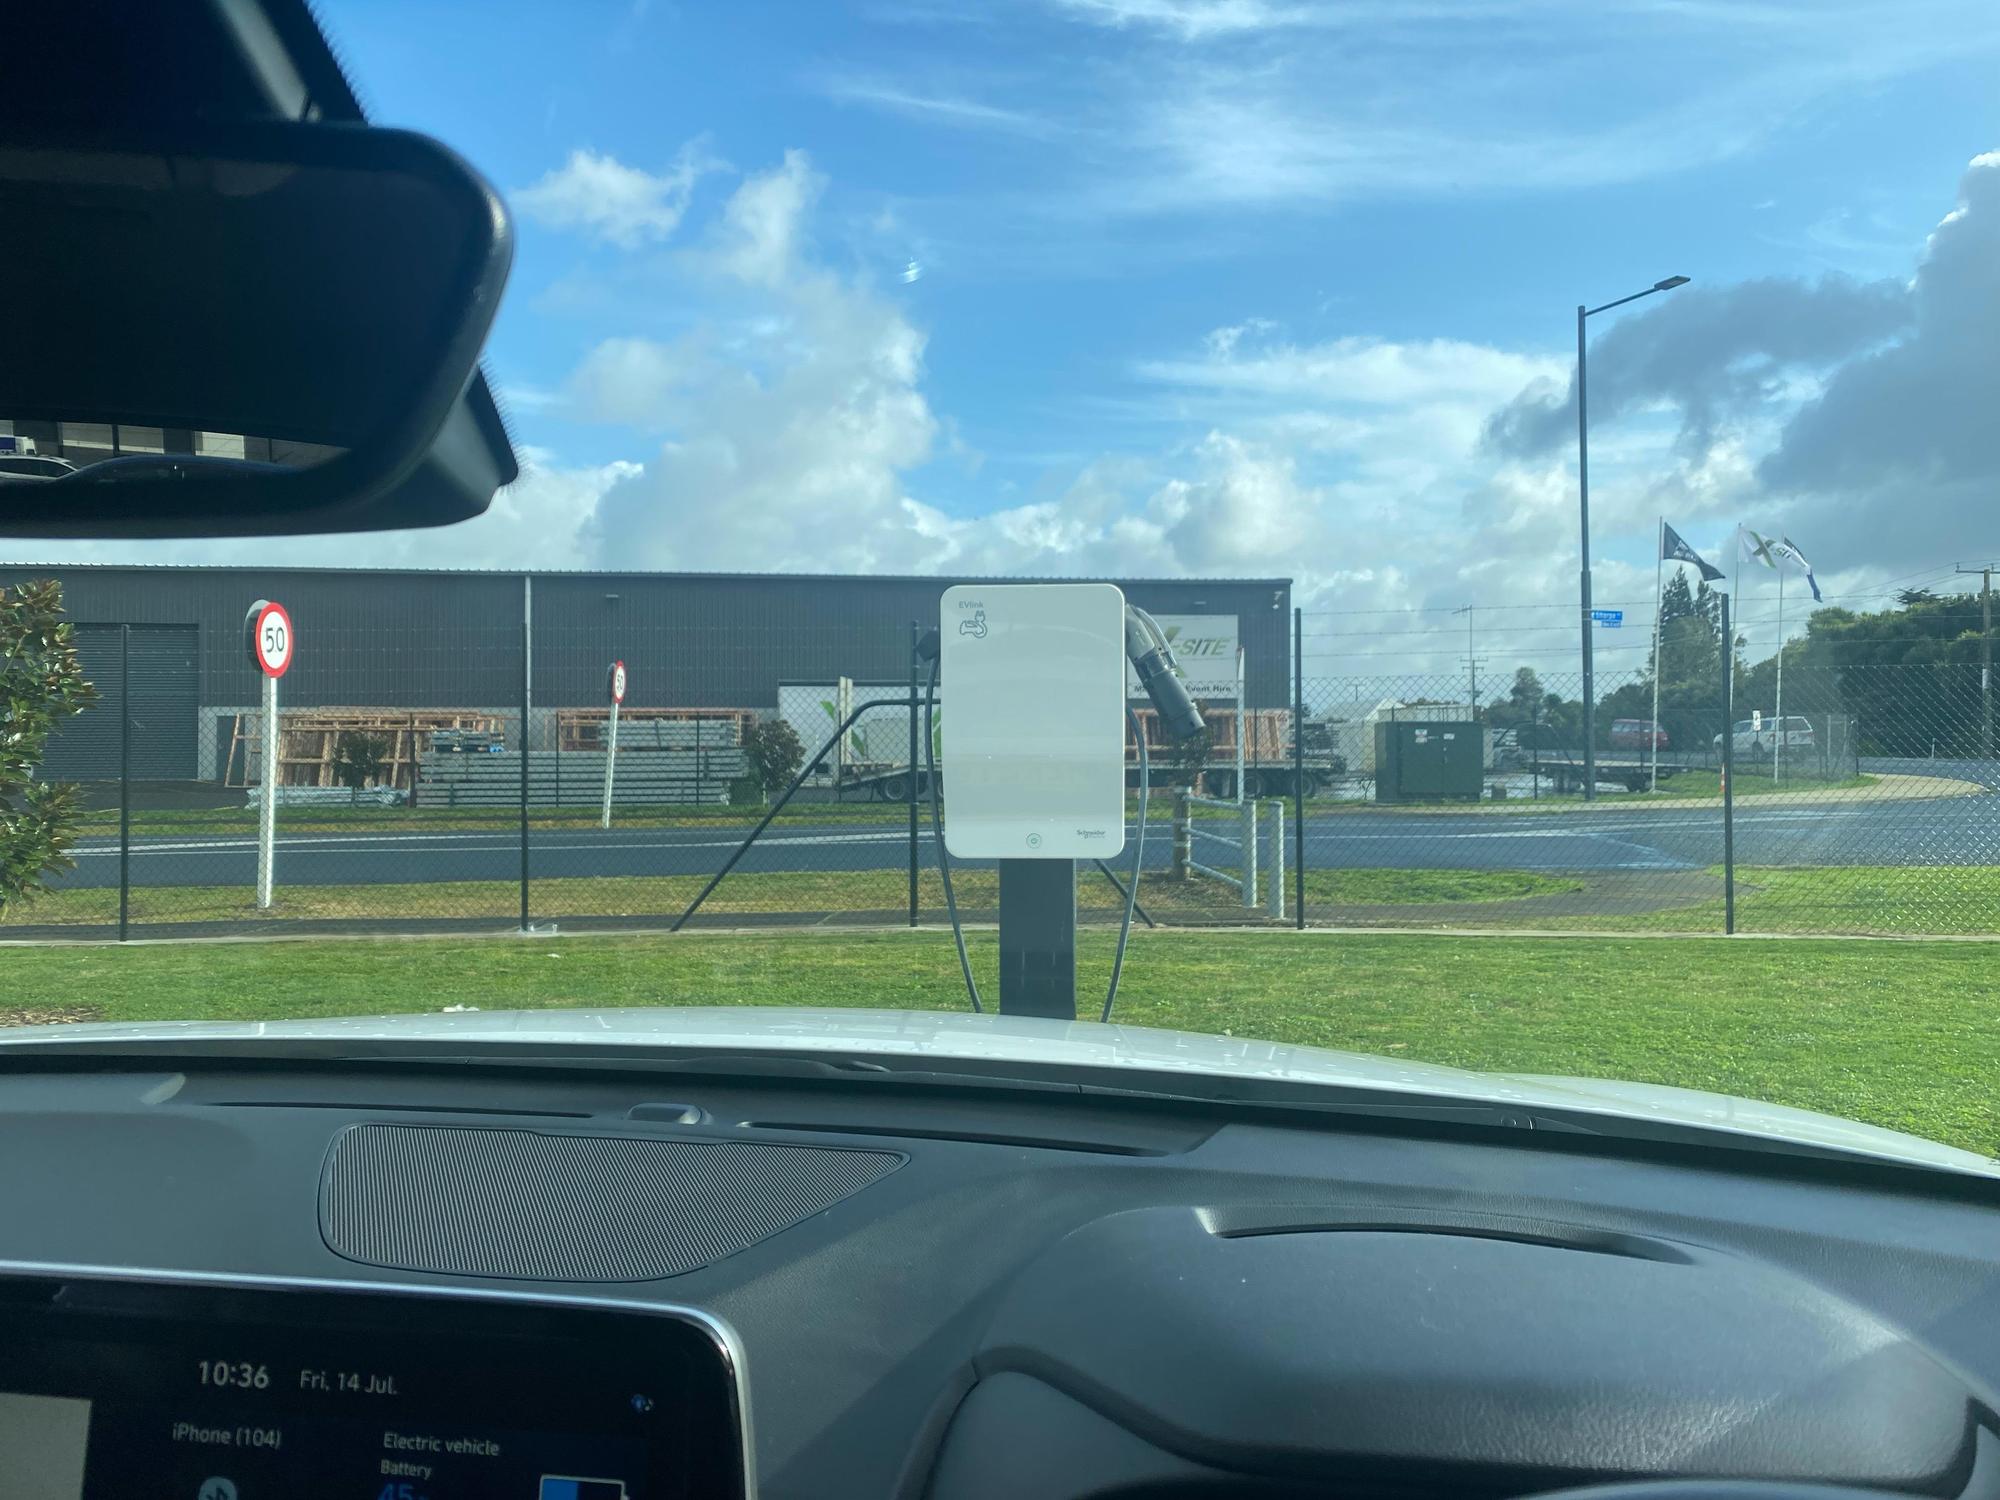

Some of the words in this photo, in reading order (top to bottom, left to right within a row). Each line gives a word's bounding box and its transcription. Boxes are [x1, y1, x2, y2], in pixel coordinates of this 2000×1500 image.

[266, 627, 285, 653] 50
[199, 1361, 269, 1389] 10:36
[338, 1373, 360, 1391] 14
[172, 1423, 231, 1444] iPhone
[236, 1427, 281, 1449] (104)
[383, 1432, 440, 1452] Electric
[445, 1439, 500, 1456] vehicle
[381, 1459, 432, 1480] Battery
